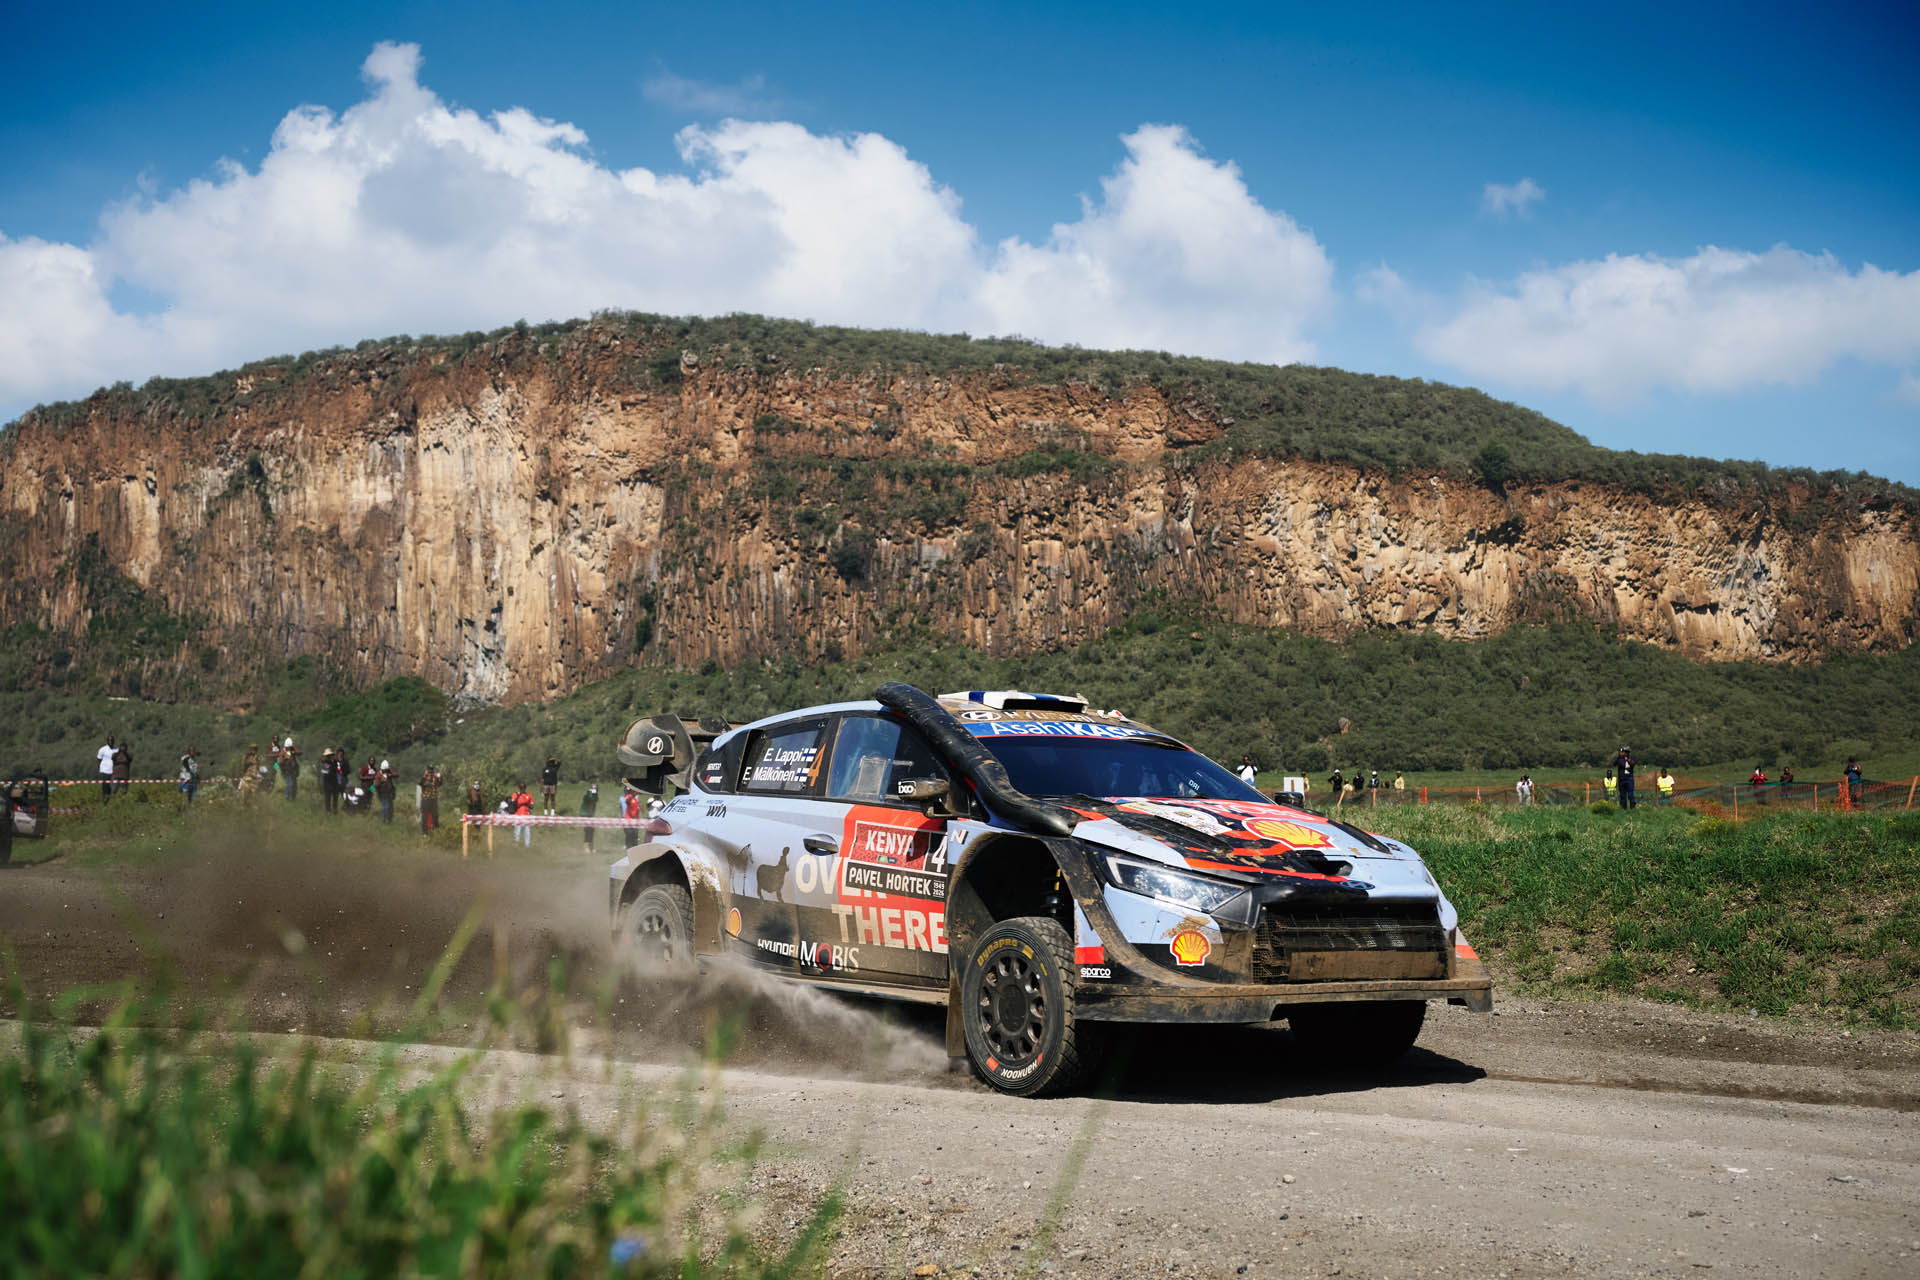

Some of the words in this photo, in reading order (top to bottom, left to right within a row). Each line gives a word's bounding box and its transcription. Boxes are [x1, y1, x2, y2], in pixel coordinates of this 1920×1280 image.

[775, 747, 804, 766] Lappi
[807, 742, 827, 787] 4
[753, 766, 796, 782] Mälkönen
[865, 830, 915, 857] KENYA
[931, 832, 948, 873] 4
[848, 867, 884, 887] PAVEL
[886, 873, 932, 896] HORTEK
[831, 903, 949, 955] THERE
[757, 938, 798, 958] HYUNDAI
[800, 940, 859, 972] MOBIS
[1080, 967, 1112, 978] sparco
